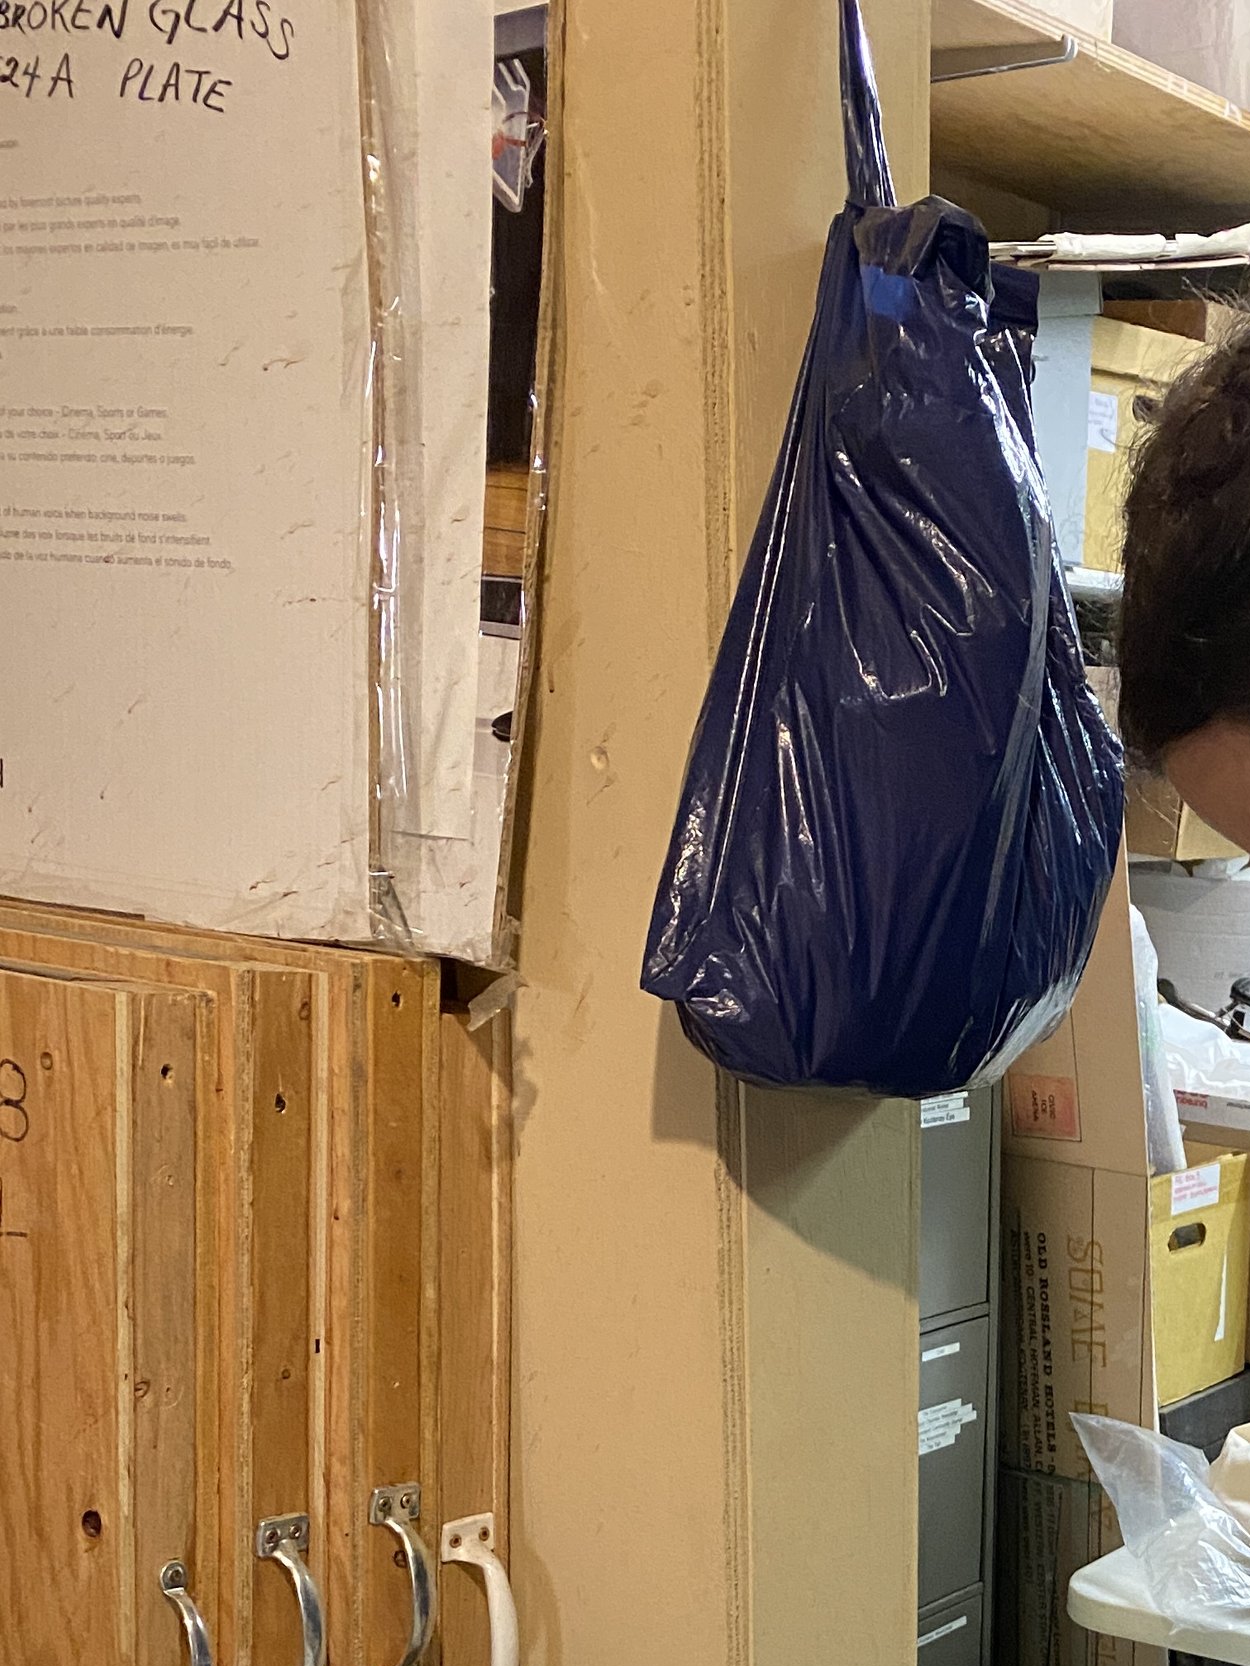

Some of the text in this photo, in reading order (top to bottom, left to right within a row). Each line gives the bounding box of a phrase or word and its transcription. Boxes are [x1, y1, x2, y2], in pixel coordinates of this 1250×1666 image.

[149, 0, 294, 60] GLASS
[119, 58, 232, 112] PLATE
[1037, 1232, 1047, 1270] OLD
[1038, 1277, 1053, 1376] ROSSLAND
[1044, 1384, 1056, 1453] HOTELS
